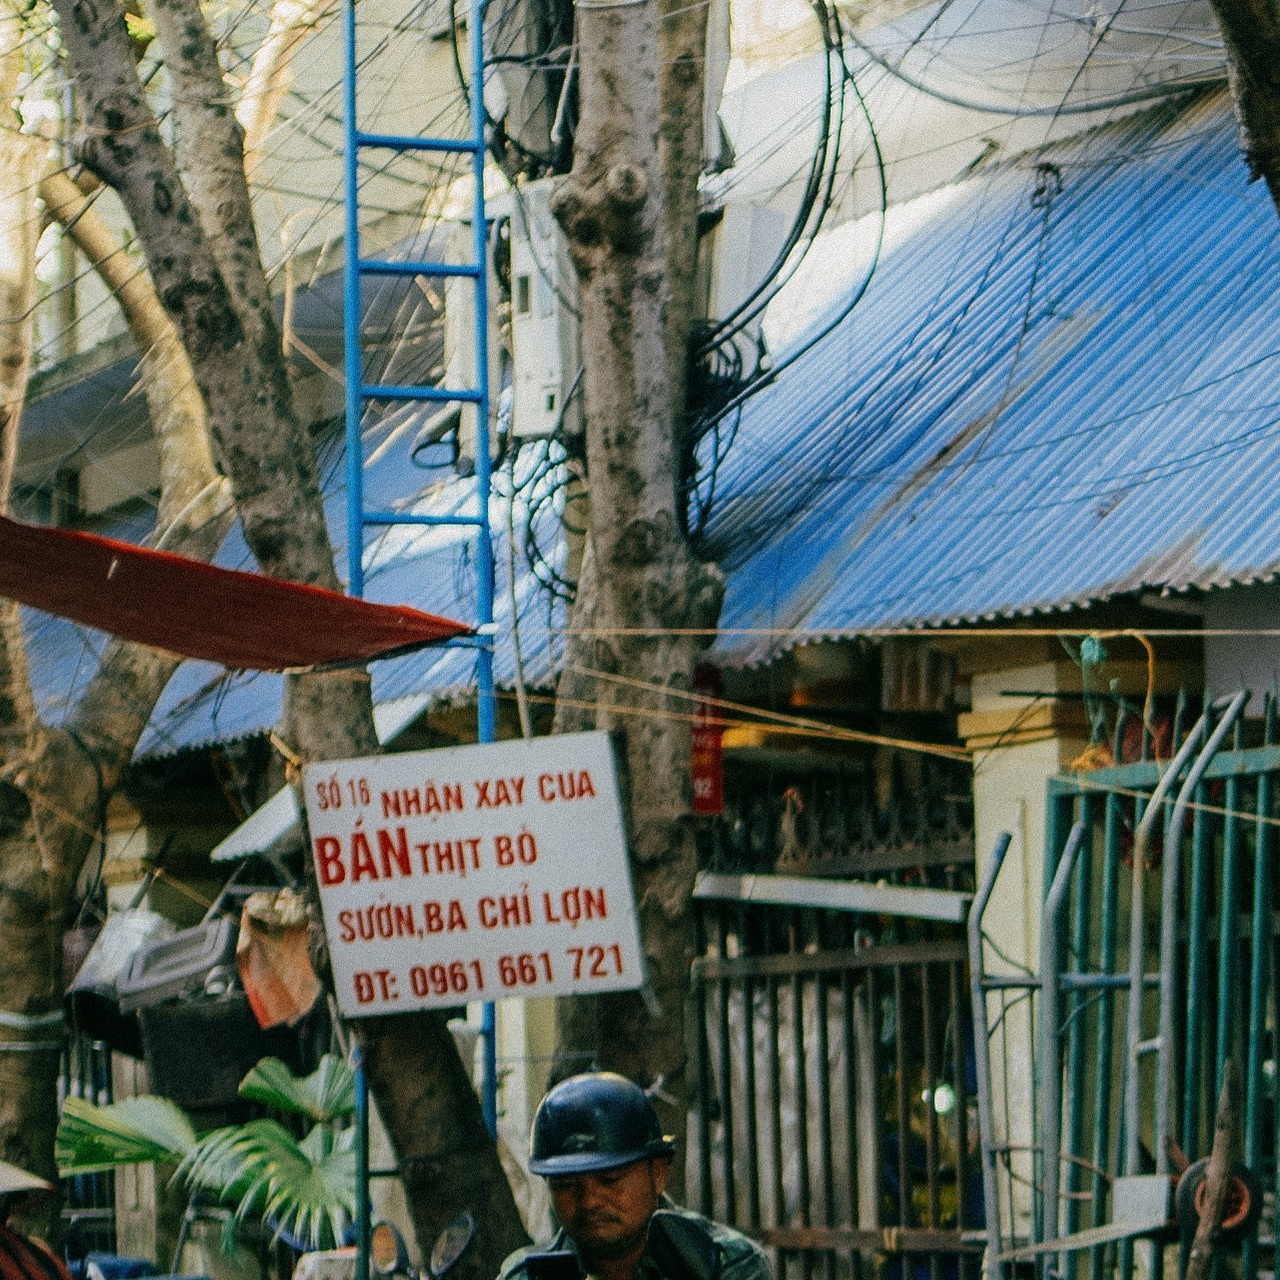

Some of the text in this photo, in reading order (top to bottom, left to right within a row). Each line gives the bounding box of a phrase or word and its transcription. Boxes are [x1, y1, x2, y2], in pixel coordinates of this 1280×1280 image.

[316, 771, 342, 811] SỐ
[347, 778, 370, 808] 16
[475, 776, 525, 810] XAY
[538, 769, 595, 803] CUA
[315, 814, 412, 886] BÁN
[414, 837, 481, 879] THỊT
[478, 881, 533, 928] CHÍ
[543, 884, 608, 928] LỢN
[410, 959, 484, 997] 0961
[498, 952, 553, 987] 661
[566, 942, 623, 980] 721
